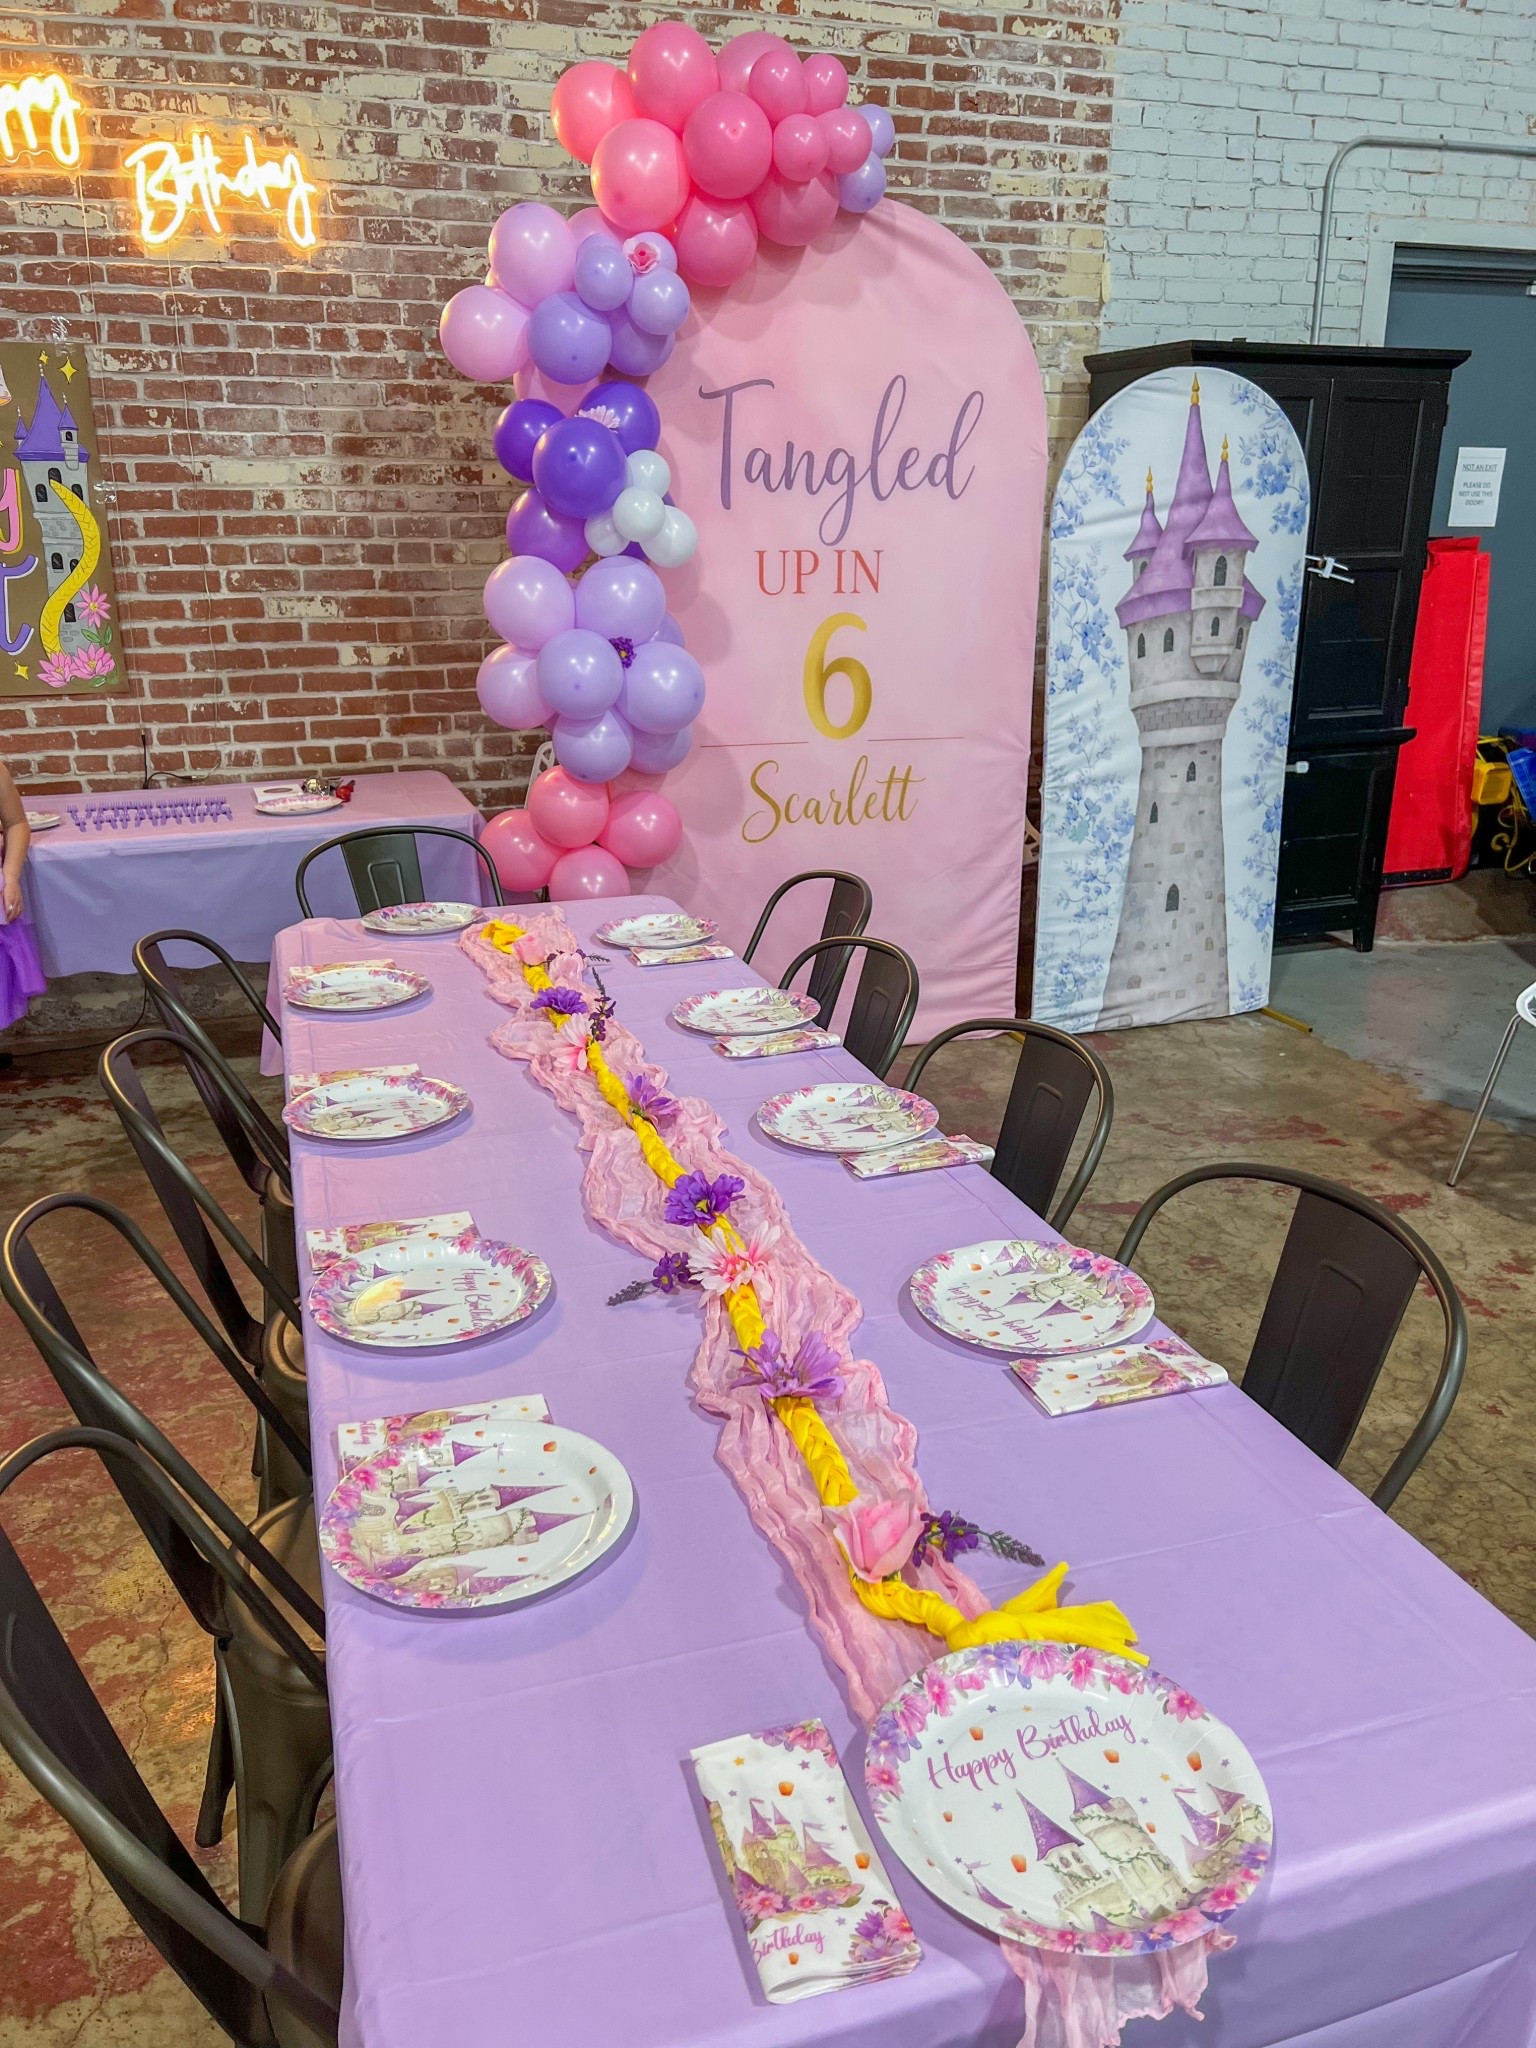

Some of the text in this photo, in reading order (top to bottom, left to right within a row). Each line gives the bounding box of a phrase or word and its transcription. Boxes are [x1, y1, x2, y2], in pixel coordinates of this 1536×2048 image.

[0, 73, 81, 165] ppy
[124, 132, 318, 247] Birthday
[699, 374, 984, 546] Tangled
[1462, 464, 1498, 472] NOT AN EXIT
[755, 549, 885, 596] UP IN
[803, 611, 873, 740] 6
[741, 754, 926, 843] Scarlett
[452, 1268, 496, 1332] Happy Birthday
[947, 1285, 1047, 1350] Happy Birthday
[927, 1710, 1136, 1791] Happy Birthday
